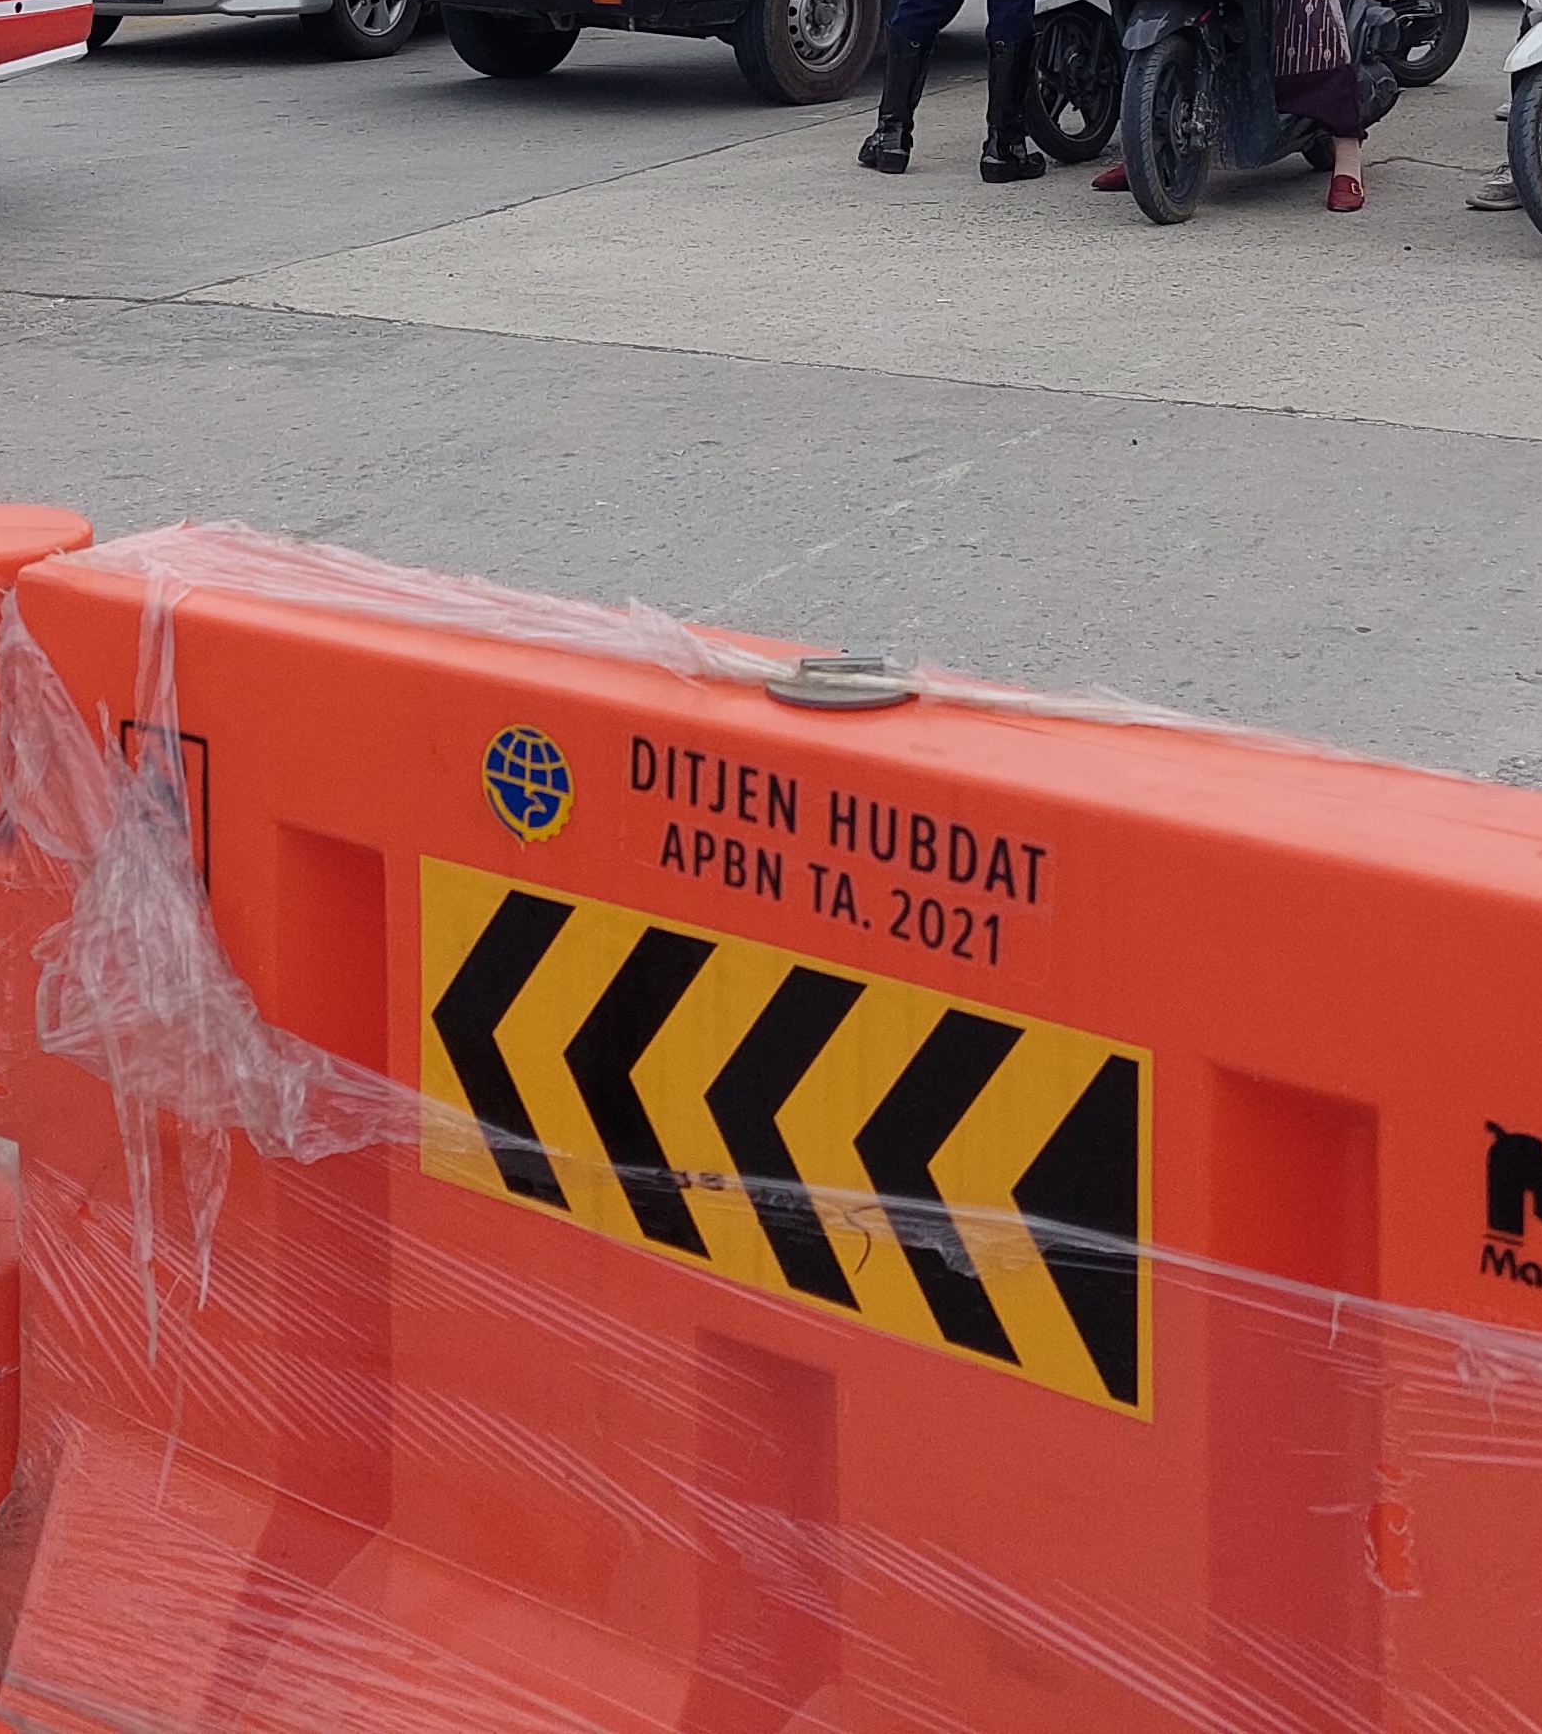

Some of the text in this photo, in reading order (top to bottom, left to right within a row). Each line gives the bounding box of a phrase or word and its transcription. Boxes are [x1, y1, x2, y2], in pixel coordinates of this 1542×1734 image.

[630, 736, 1047, 905] DITJEN HUBDAT
[661, 822, 1001, 966] APBN TA. 2021
